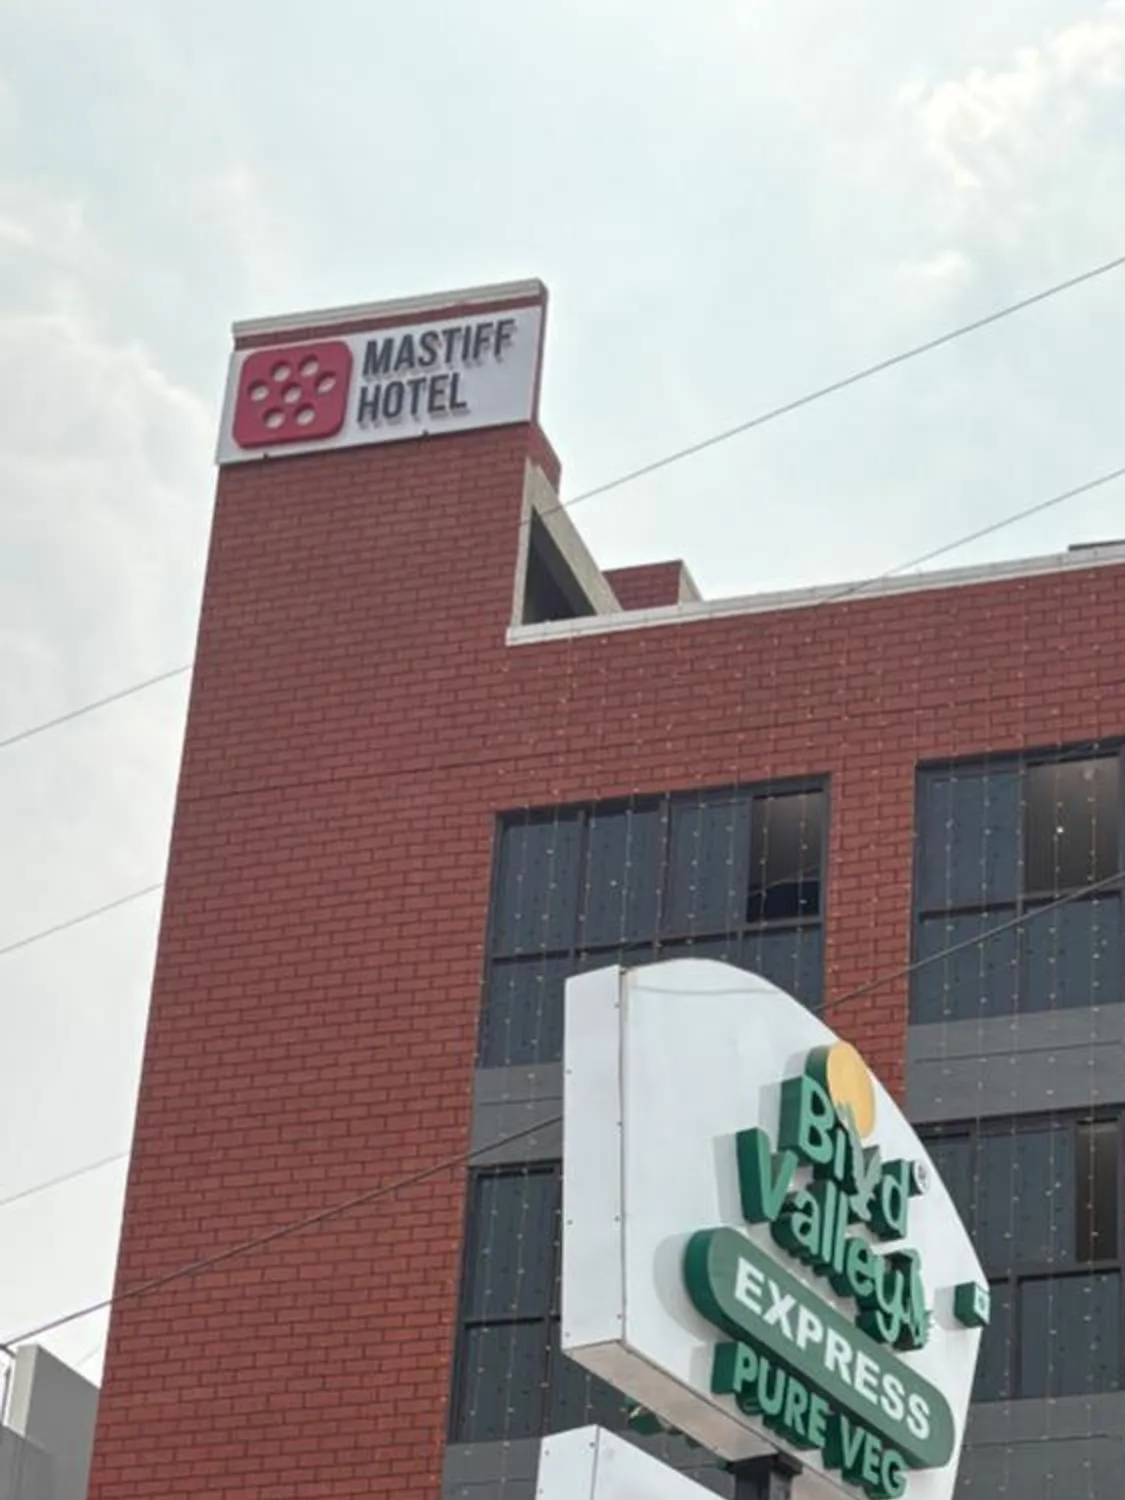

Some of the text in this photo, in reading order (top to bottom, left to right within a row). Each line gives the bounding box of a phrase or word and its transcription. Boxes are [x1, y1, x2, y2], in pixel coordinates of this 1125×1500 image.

[357, 373, 468, 424] HOTEL
[362, 319, 515, 377] MASTIFF
[740, 1128, 914, 1346] Valley
[718, 1342, 908, 1500] PURE VEG
[735, 1257, 932, 1440] EXPRESS
